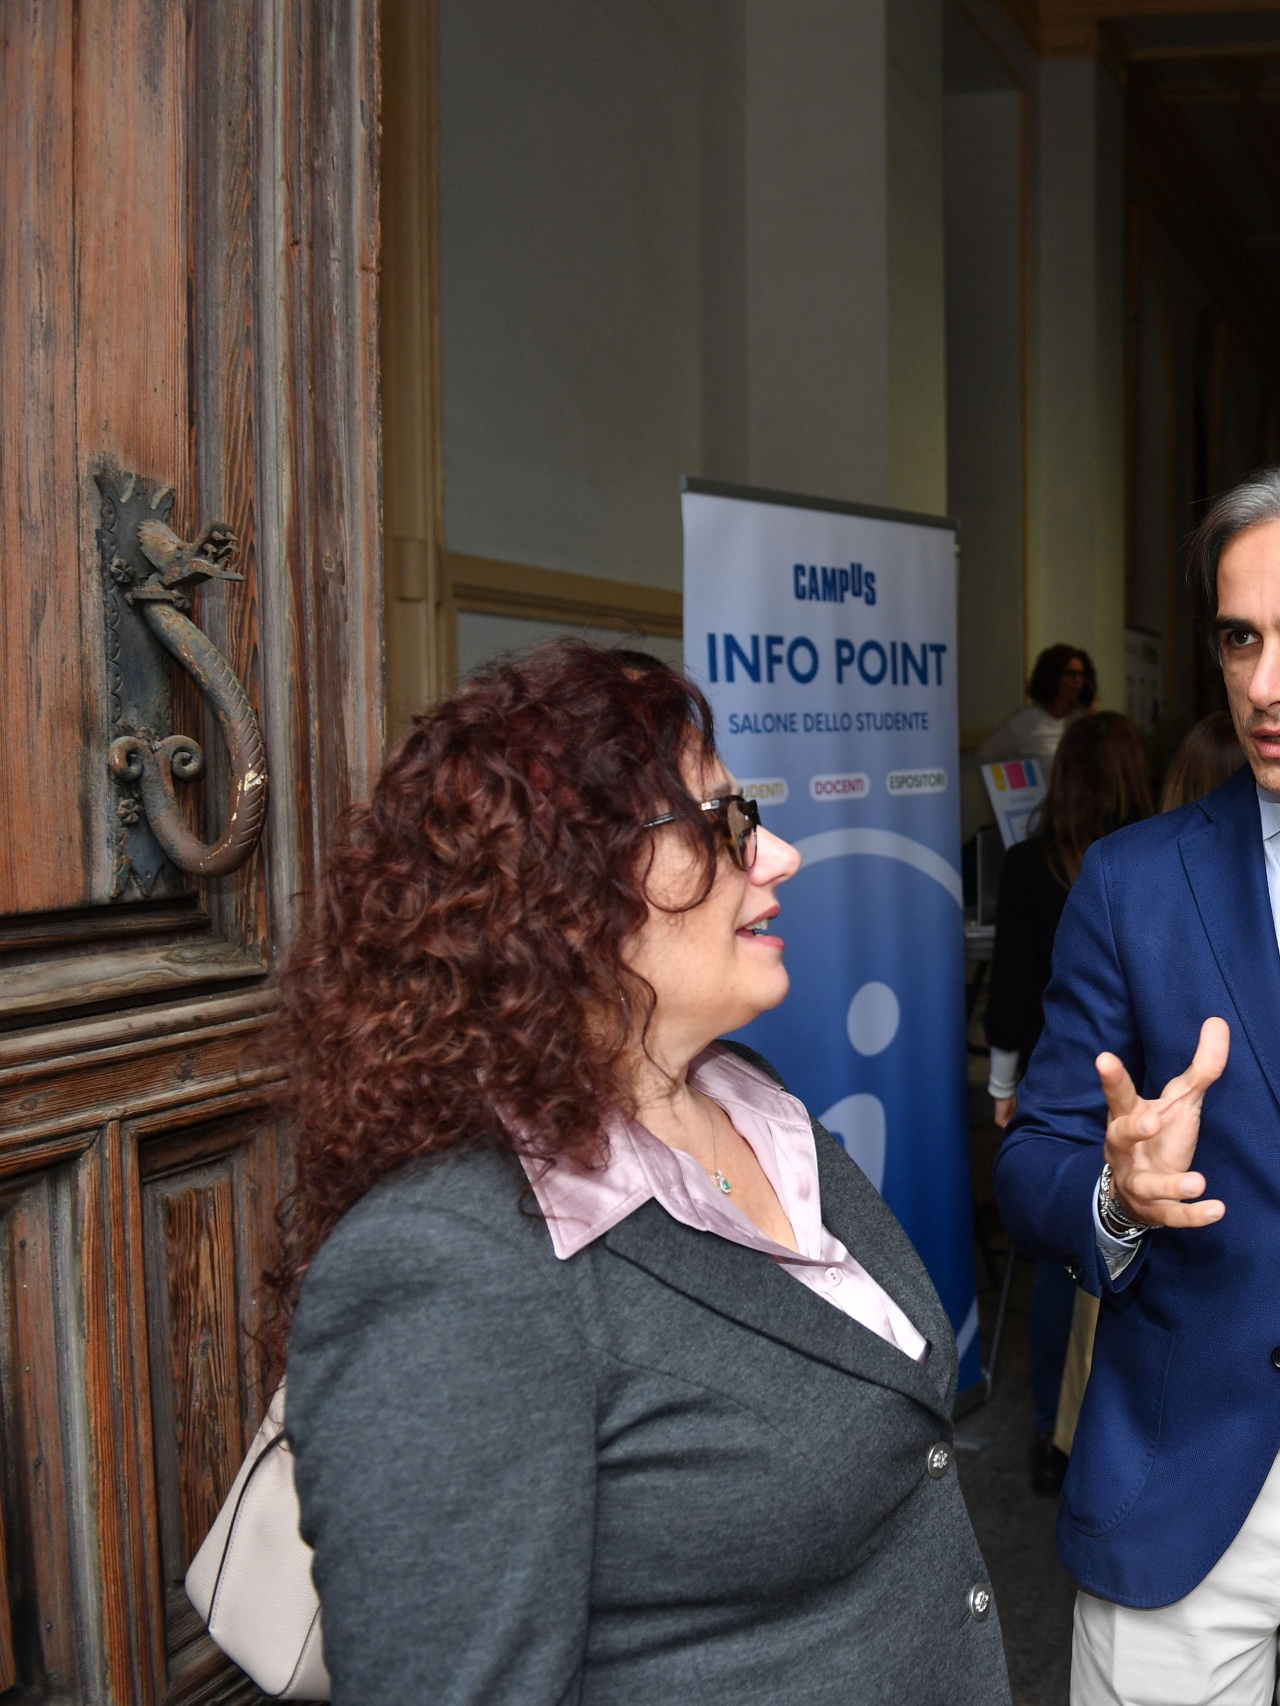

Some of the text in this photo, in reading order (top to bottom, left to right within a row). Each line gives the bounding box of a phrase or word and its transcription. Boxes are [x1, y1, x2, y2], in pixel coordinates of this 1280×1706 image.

[792, 561, 877, 606] CAMPUS
[706, 632, 947, 687] INFO POINT
[728, 711, 929, 734] SALONE DELLO STUDENTE
[814, 777, 865, 796] DOCENTI
[889, 772, 947, 791] ESPOSITORI
